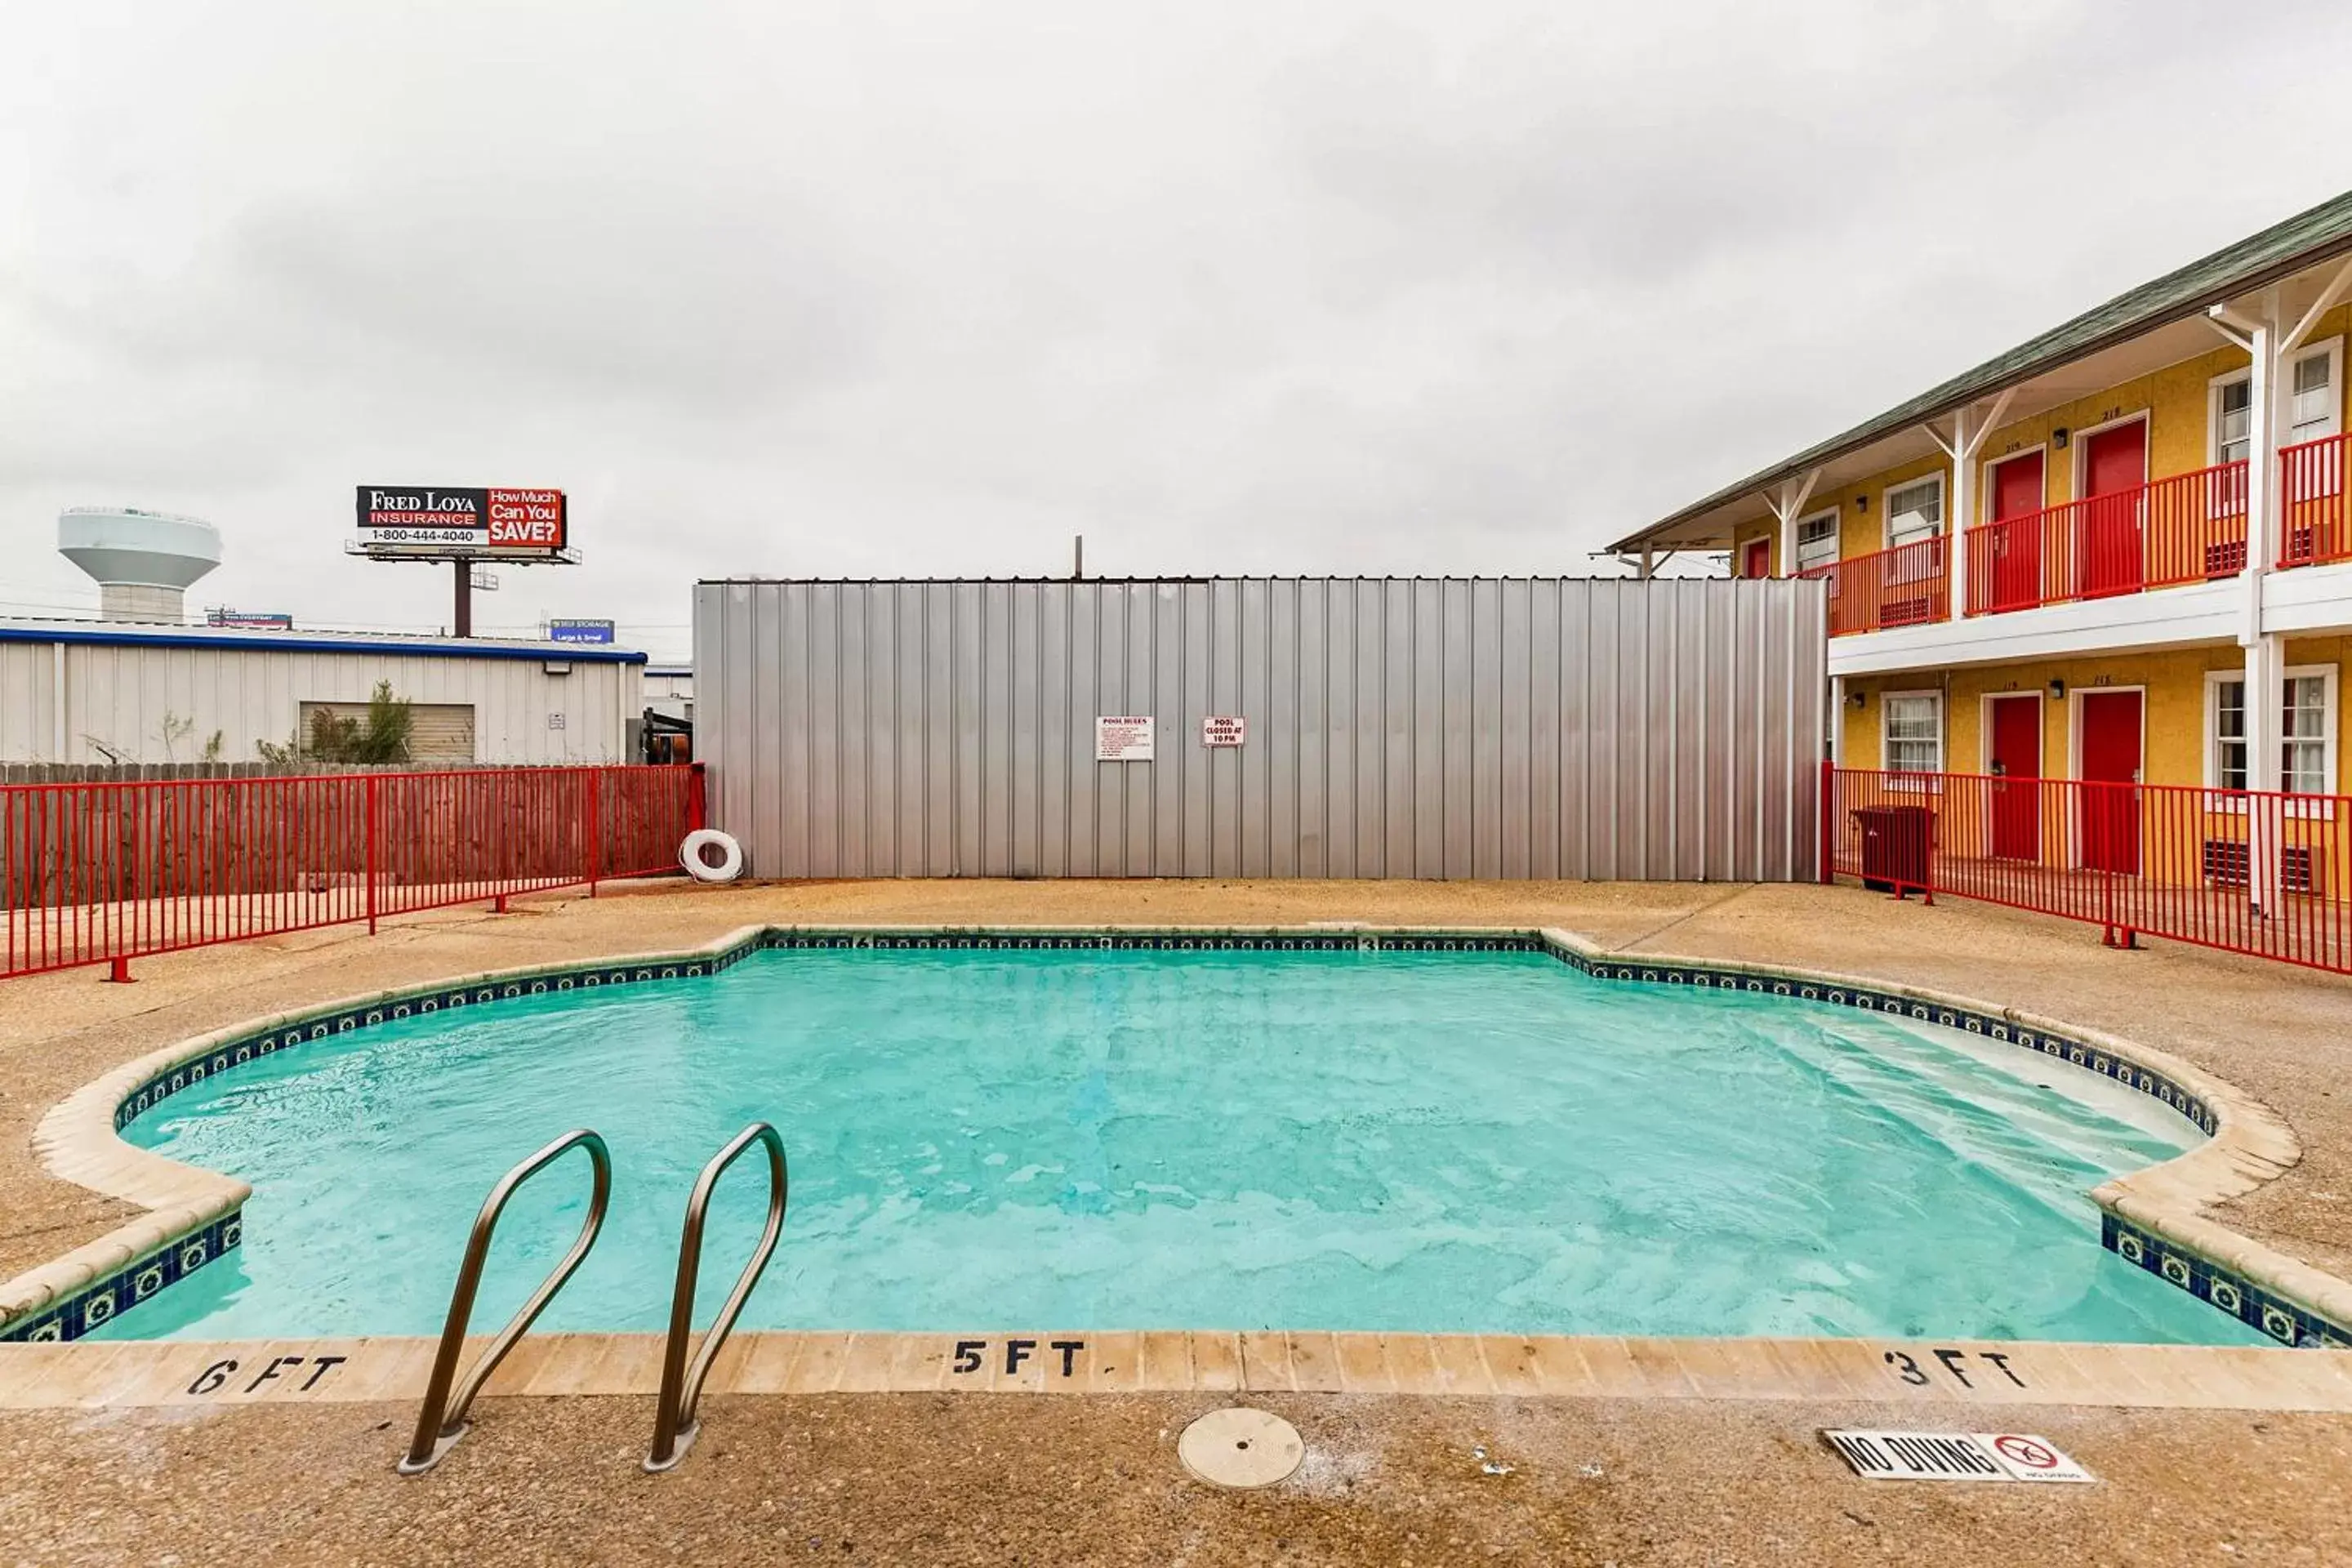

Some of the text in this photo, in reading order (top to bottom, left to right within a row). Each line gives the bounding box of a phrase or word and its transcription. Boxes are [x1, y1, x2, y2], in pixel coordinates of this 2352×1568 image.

[370, 490, 476, 512] FRED LOYA
[491, 490, 556, 504] How Much
[371, 512, 476, 525] INSURANCE
[491, 505, 556, 520] Can You
[373, 529, 474, 541] 1-800-444-4040
[491, 521, 555, 541] SAVE?
[953, 1339, 1085, 1378] 5 FT
[1884, 1349, 2027, 1388] 3 FT
[187, 1356, 348, 1395] 6 FT
[1834, 1434, 2000, 1474] NO DIVING
